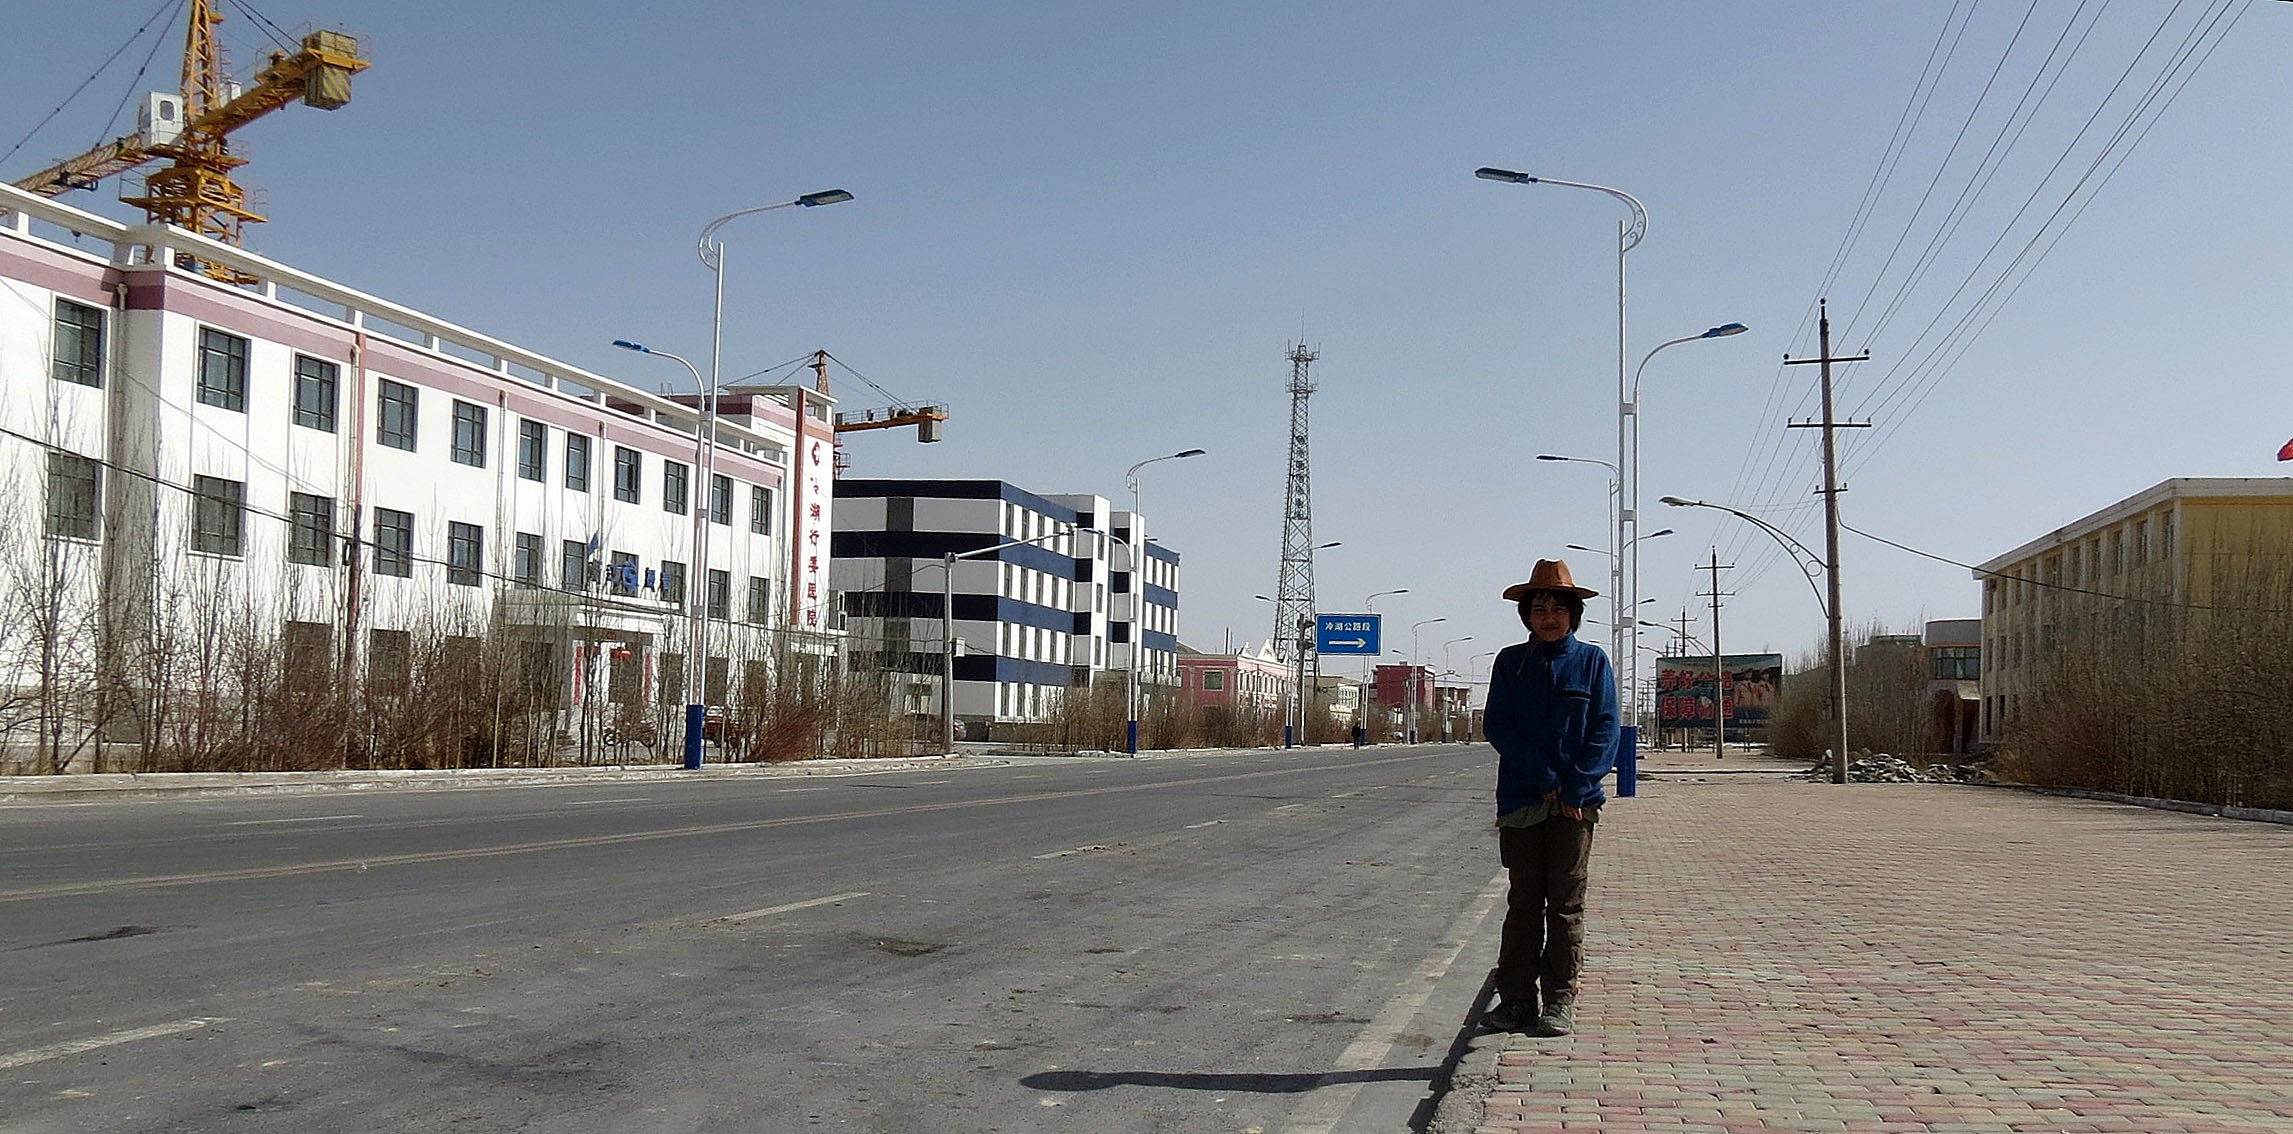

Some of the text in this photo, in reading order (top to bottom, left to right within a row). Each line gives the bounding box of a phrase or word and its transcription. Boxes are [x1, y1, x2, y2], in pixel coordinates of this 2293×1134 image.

[1325, 622, 1371, 632] 冷湖公路段
